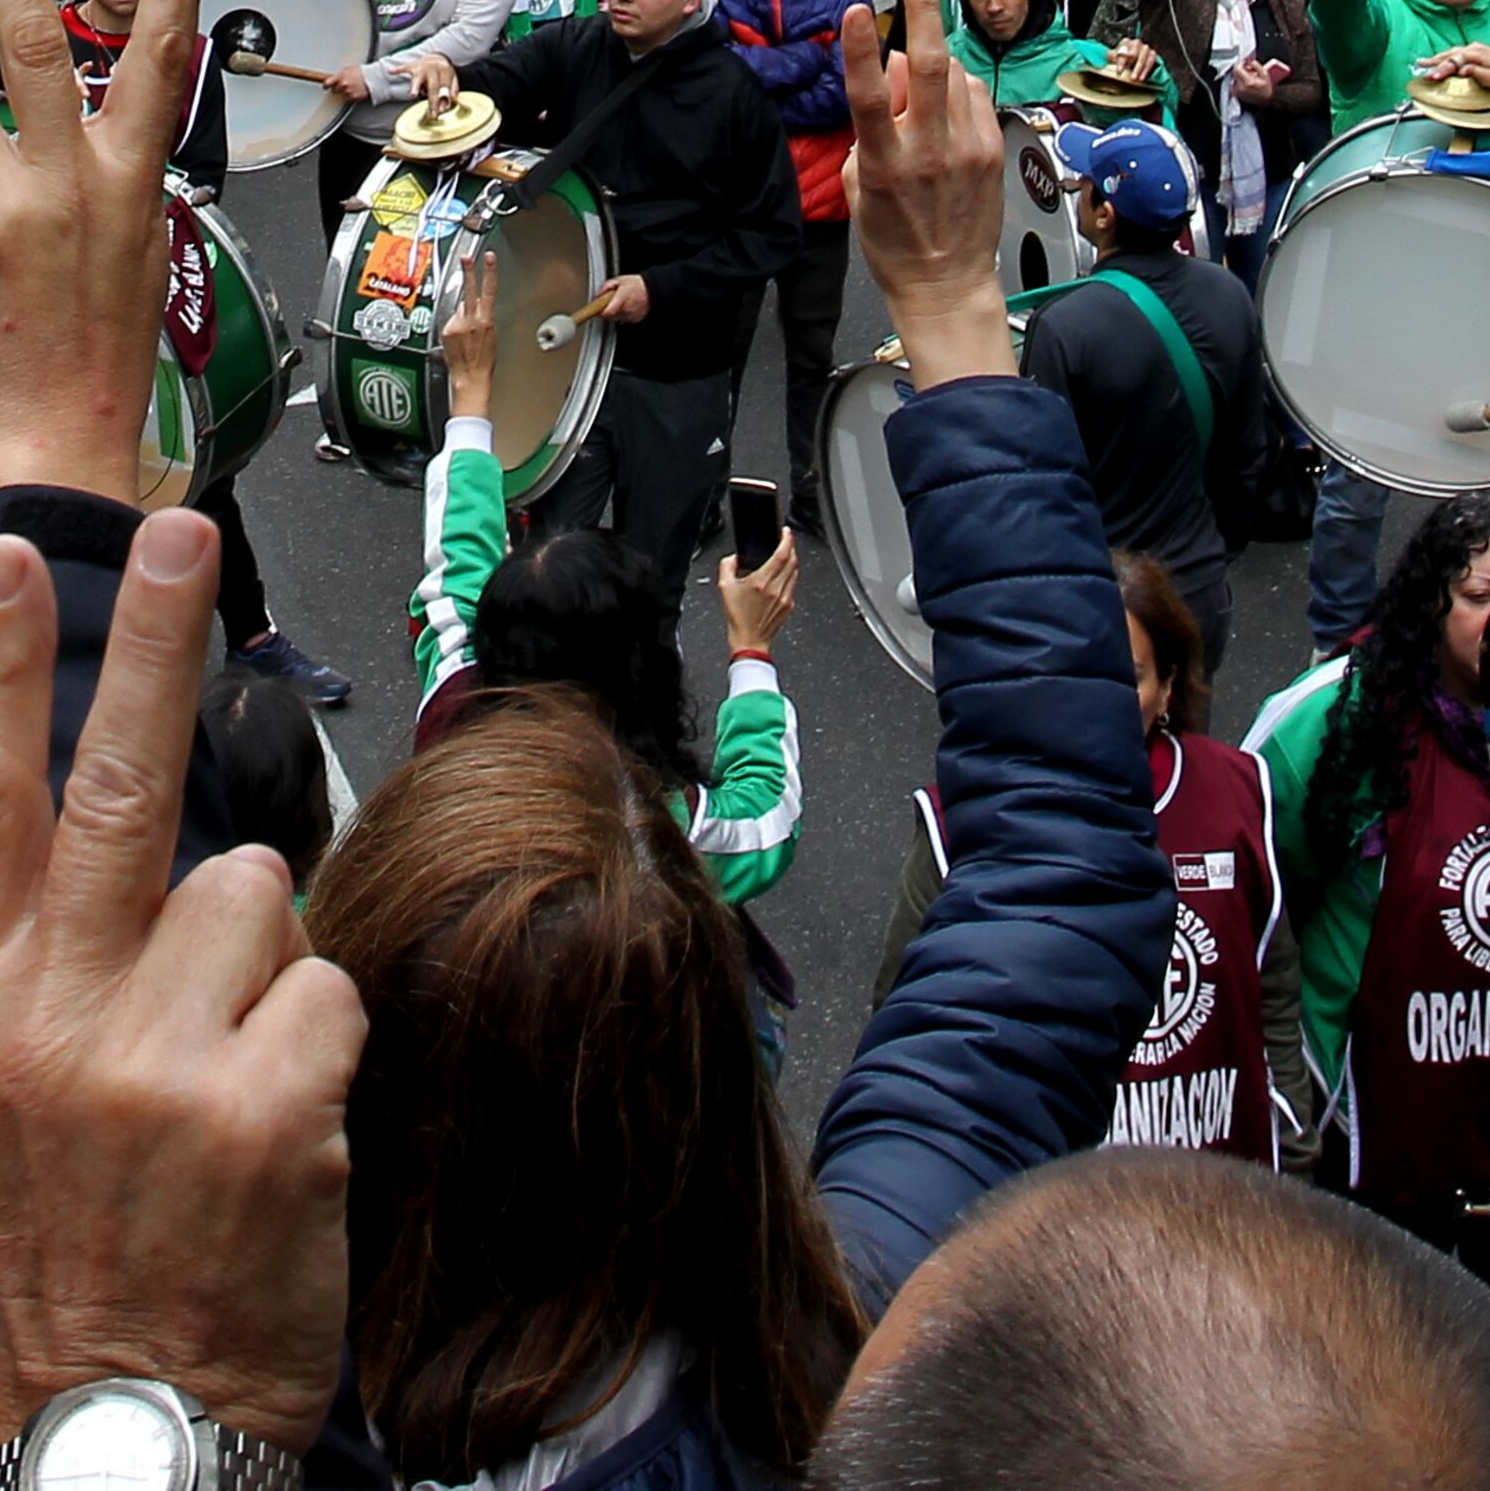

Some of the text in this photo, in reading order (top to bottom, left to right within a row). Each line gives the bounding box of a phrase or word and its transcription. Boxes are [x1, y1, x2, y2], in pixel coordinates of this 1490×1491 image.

[365, 374, 408, 421] ATE
[1439, 906, 1465, 956] PARA
[1181, 981, 1218, 1044] NACION
[1112, 1068, 1239, 1150] ANIZACION
